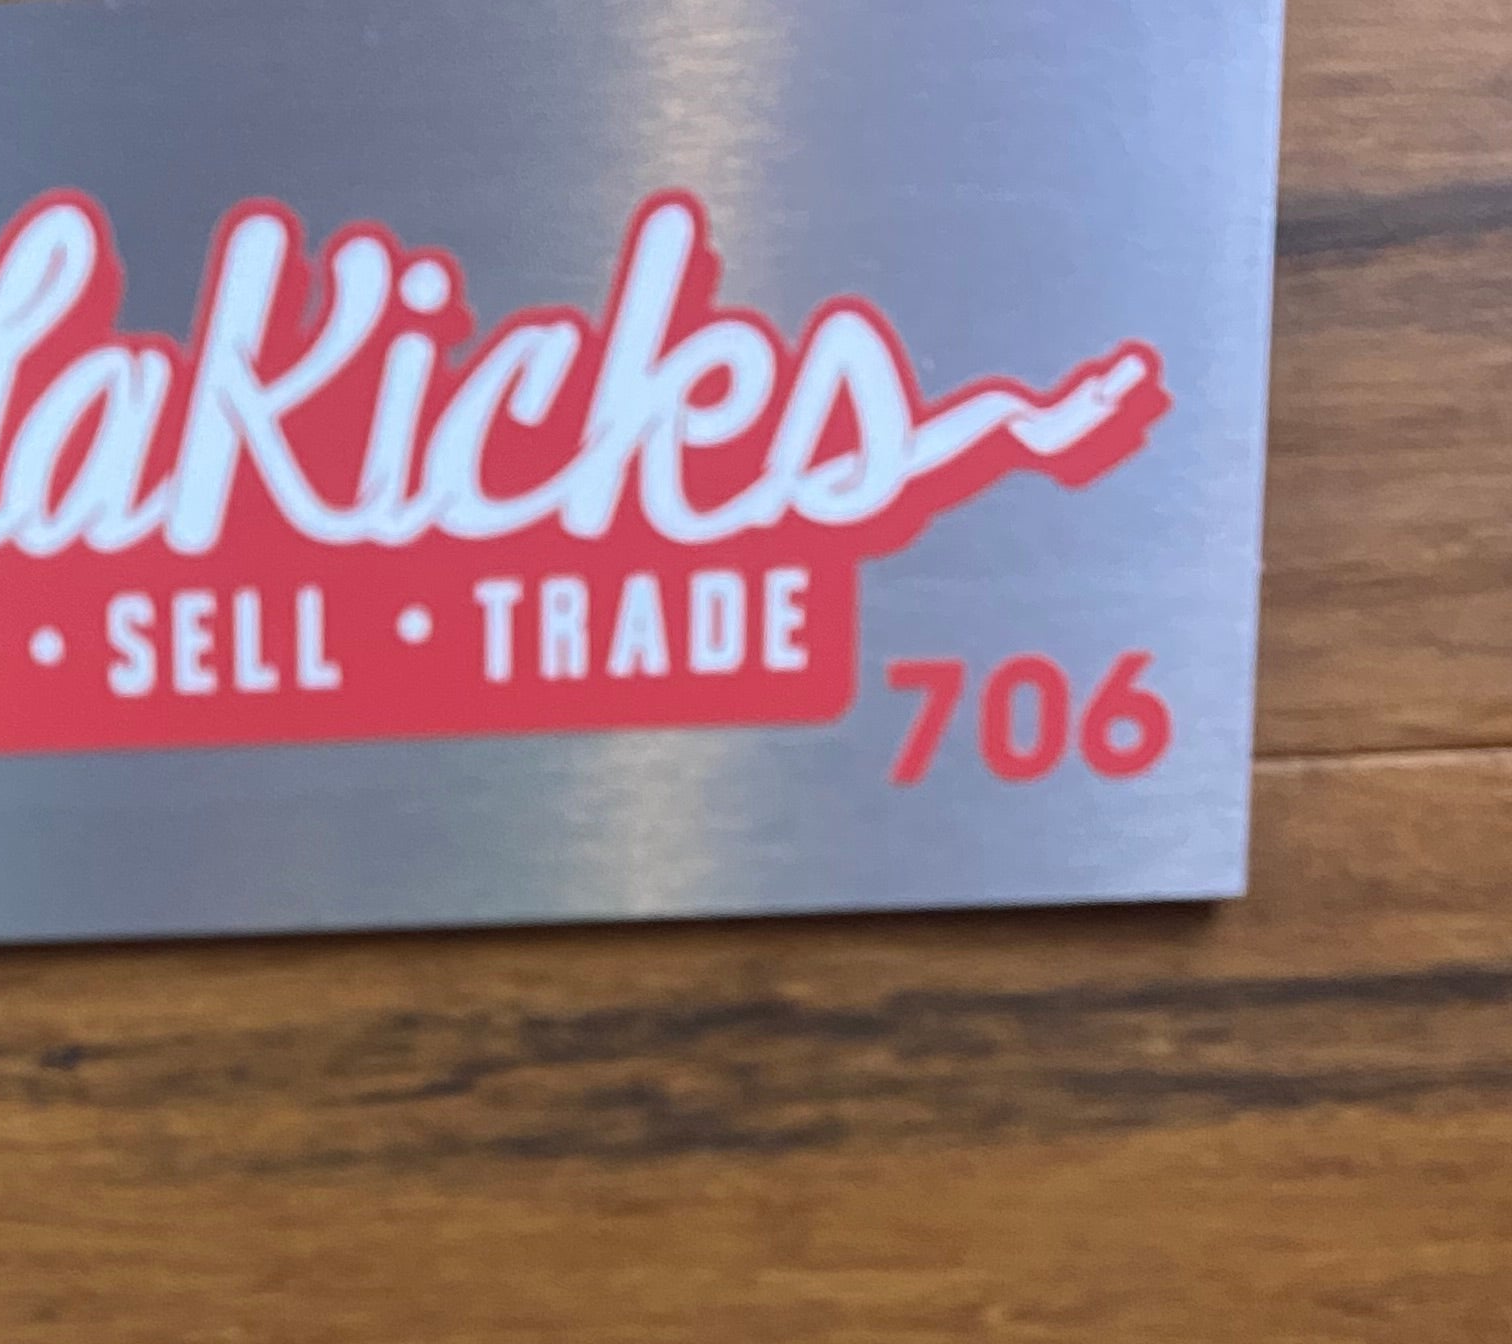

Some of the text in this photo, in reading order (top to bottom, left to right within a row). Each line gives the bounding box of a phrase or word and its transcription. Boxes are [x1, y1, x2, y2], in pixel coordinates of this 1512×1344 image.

[107, 584, 342, 698] SELL
[473, 566, 810, 683] TRADE
[886, 650, 1173, 787] 706
